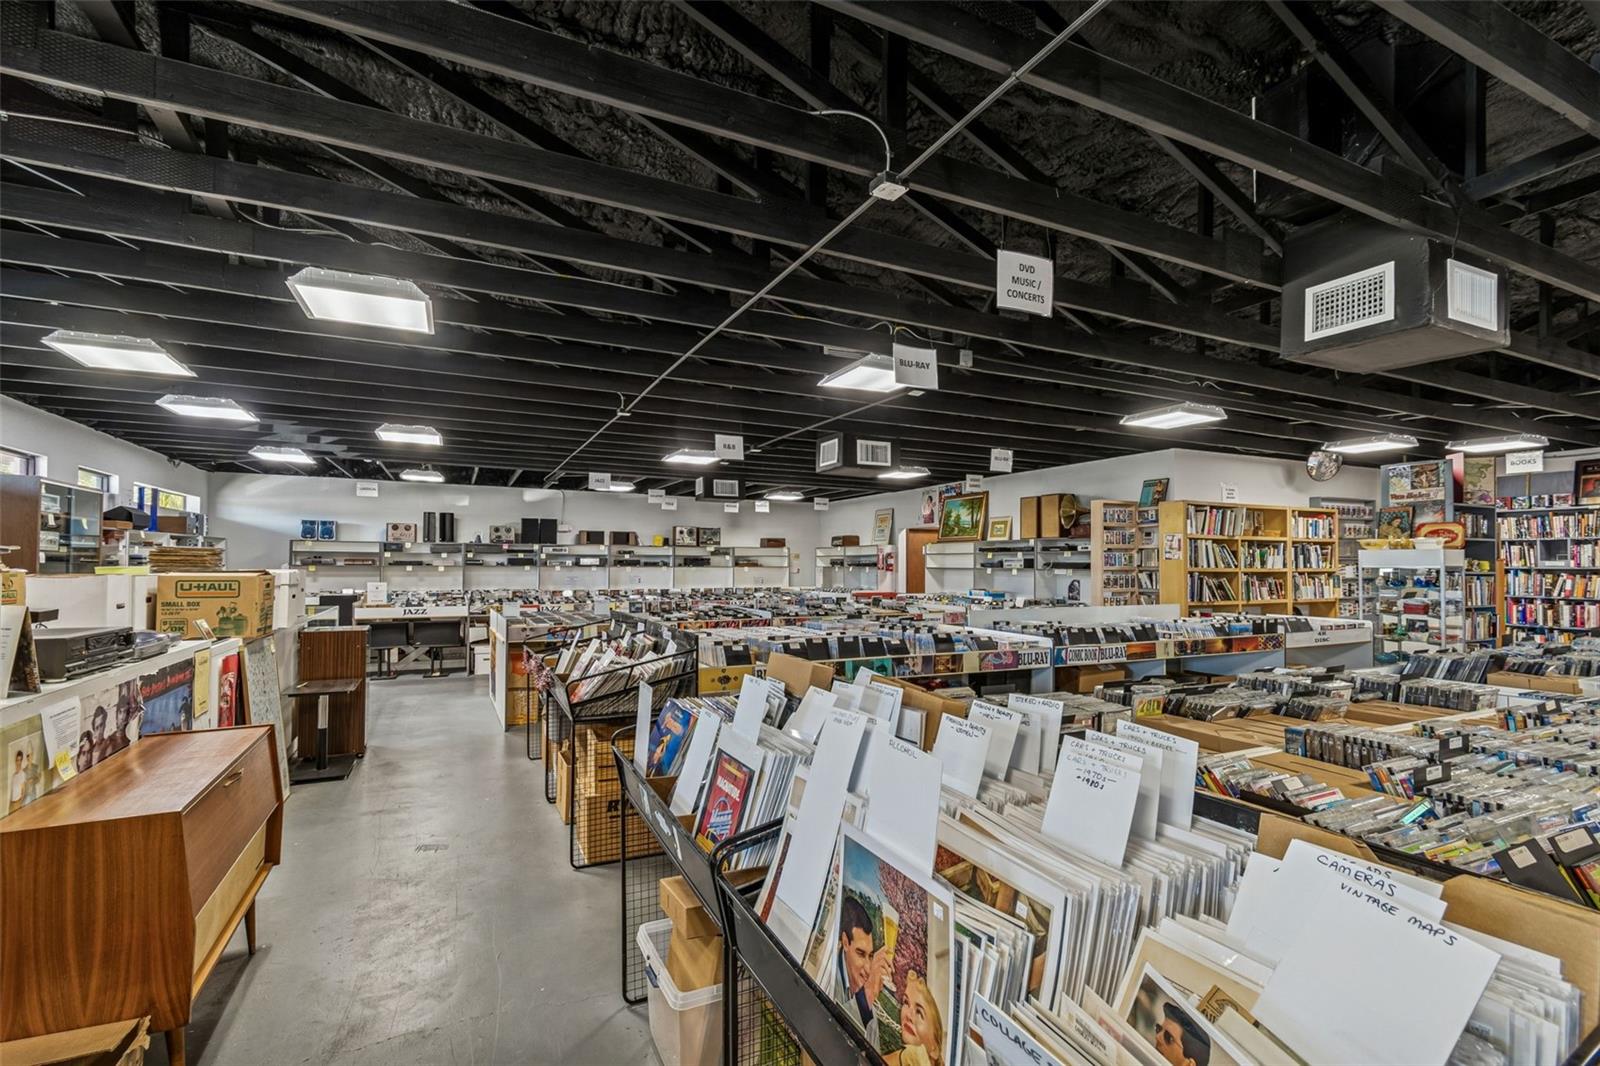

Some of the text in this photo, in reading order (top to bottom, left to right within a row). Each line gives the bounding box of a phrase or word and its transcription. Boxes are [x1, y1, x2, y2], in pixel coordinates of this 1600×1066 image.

[1019, 263, 1035, 274] DVD
[1011, 276, 1036, 288] MUSIC
[1007, 289, 1045, 304] CONCERTS
[899, 359, 930, 369] BLU-RAY
[180, 583, 236, 591] U-HAUL
[402, 608, 428, 616] JAZZ
[1018, 651, 1049, 665] BLU-RAY
[1069, 646, 1127, 662] COMIC BOOK BLU-RAY
[1015, 696, 1037, 705] STEREO
[1042, 700, 1060, 710] RADIO
[1123, 724, 1139, 734] CARS
[1151, 732, 1177, 744] TRUCKS
[889, 739, 918, 759] ALCOHOL
[1070, 740, 1089, 751] CARS
[1099, 749, 1126, 763] TRUCKS
[1119, 742, 1146, 754] TRUCKS
[1316, 854, 1397, 897] CAMERAS
[1340, 882, 1458, 946] VINTAGE MAPS
[980, 1007, 1042, 1066] COLLAGE
